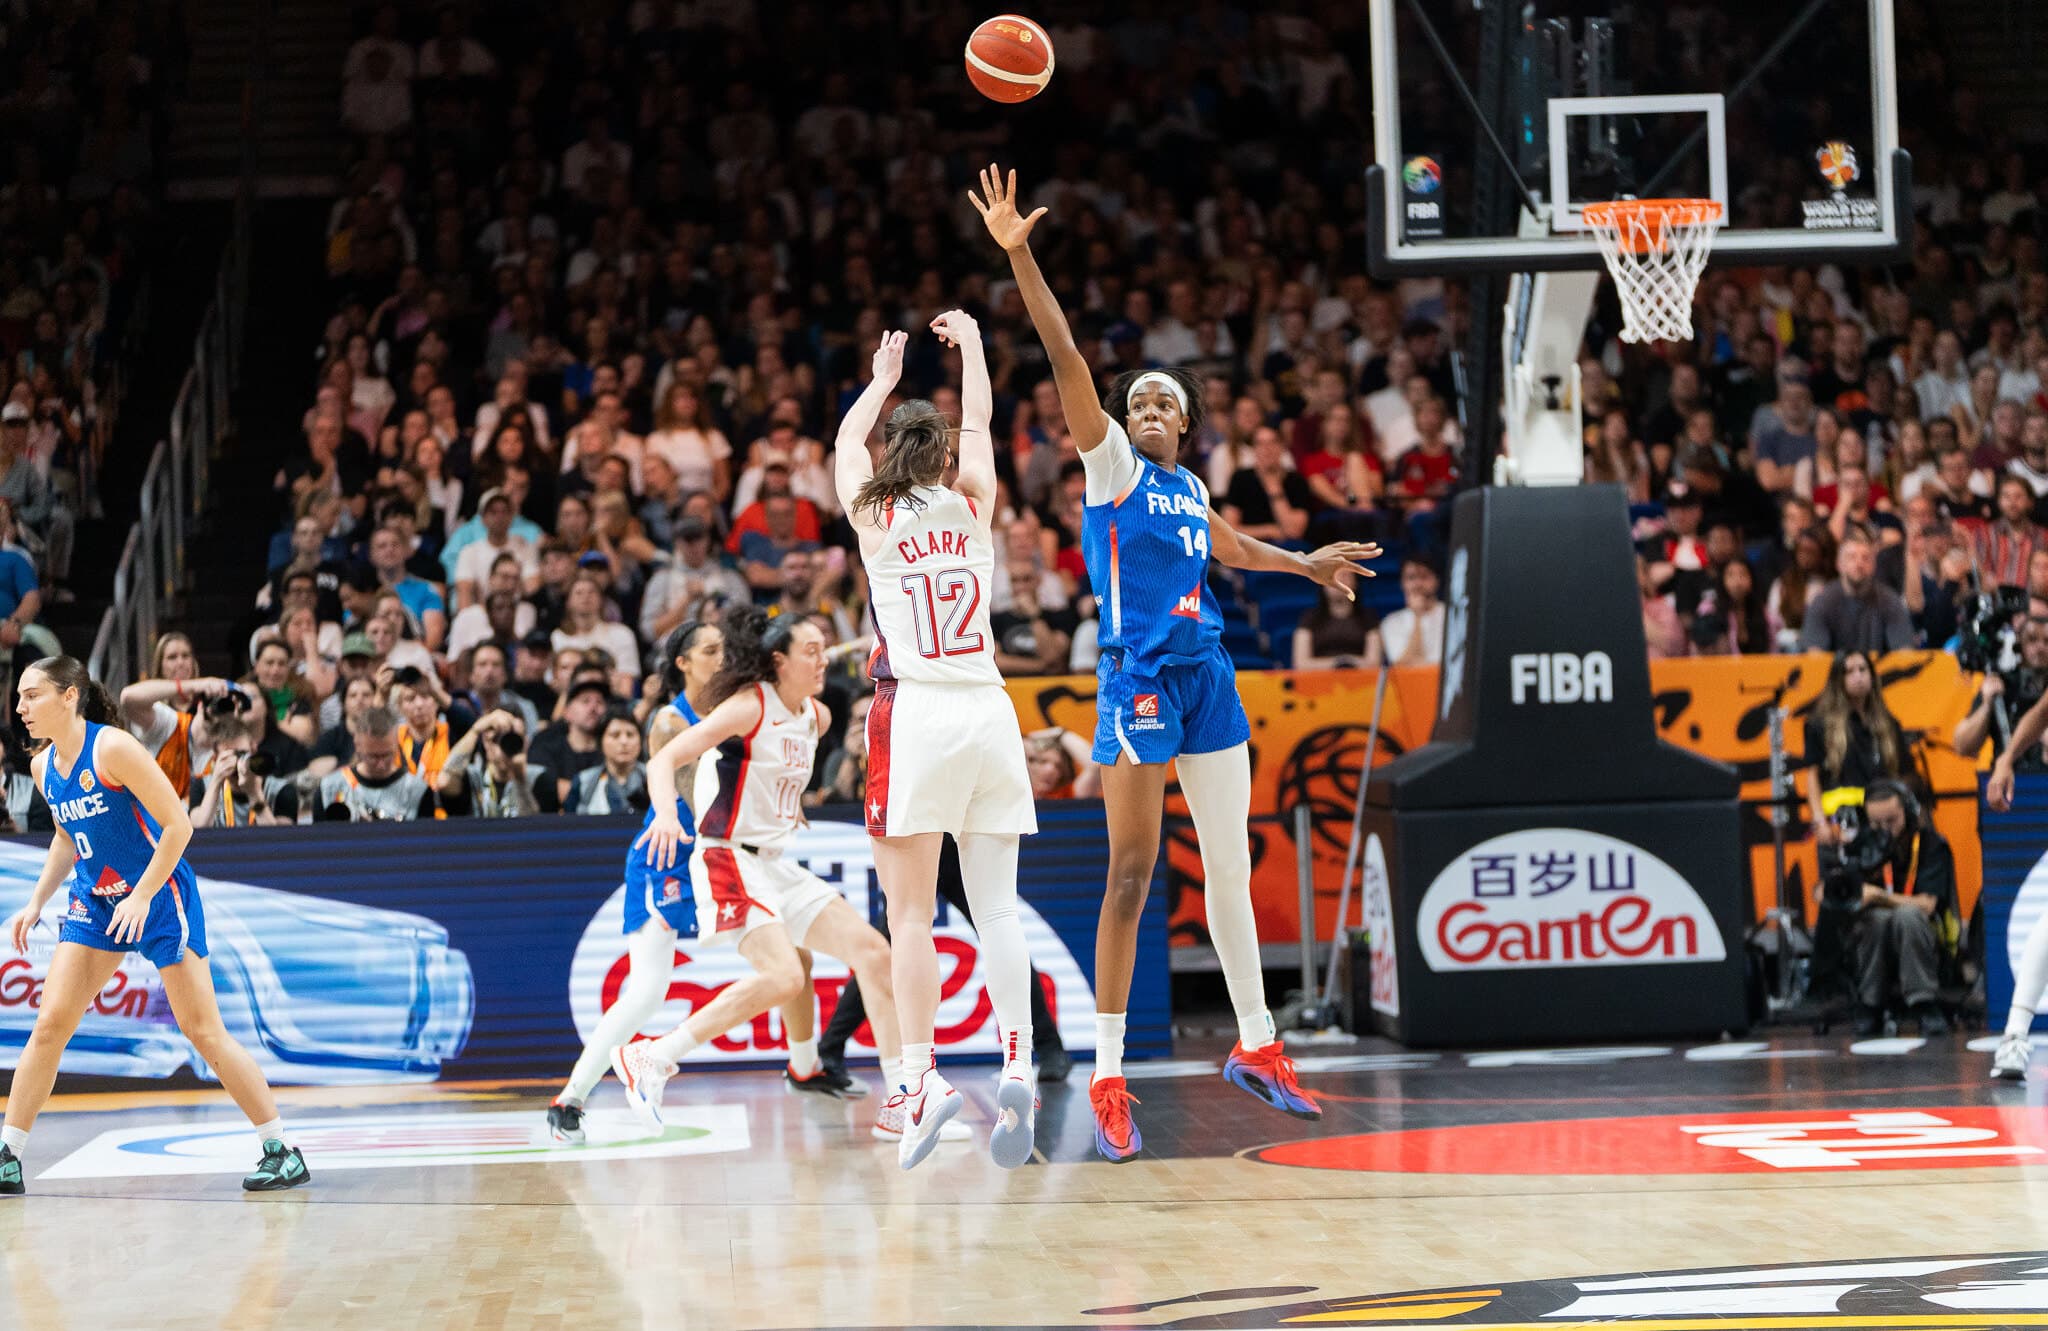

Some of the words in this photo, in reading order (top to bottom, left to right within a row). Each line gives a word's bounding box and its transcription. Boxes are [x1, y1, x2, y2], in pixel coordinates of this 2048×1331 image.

[1407, 202, 1440, 219] FIBA
[898, 531, 970, 564] CLARK
[1177, 526, 1208, 560] 14
[901, 568, 984, 659] 12
[1511, 651, 1613, 704] FIBA
[50, 792, 109, 824] RANCE
[74, 832, 93, 860] 0
[91, 879, 127, 896] MAIF
[1471, 850, 1636, 898] 百岁山
